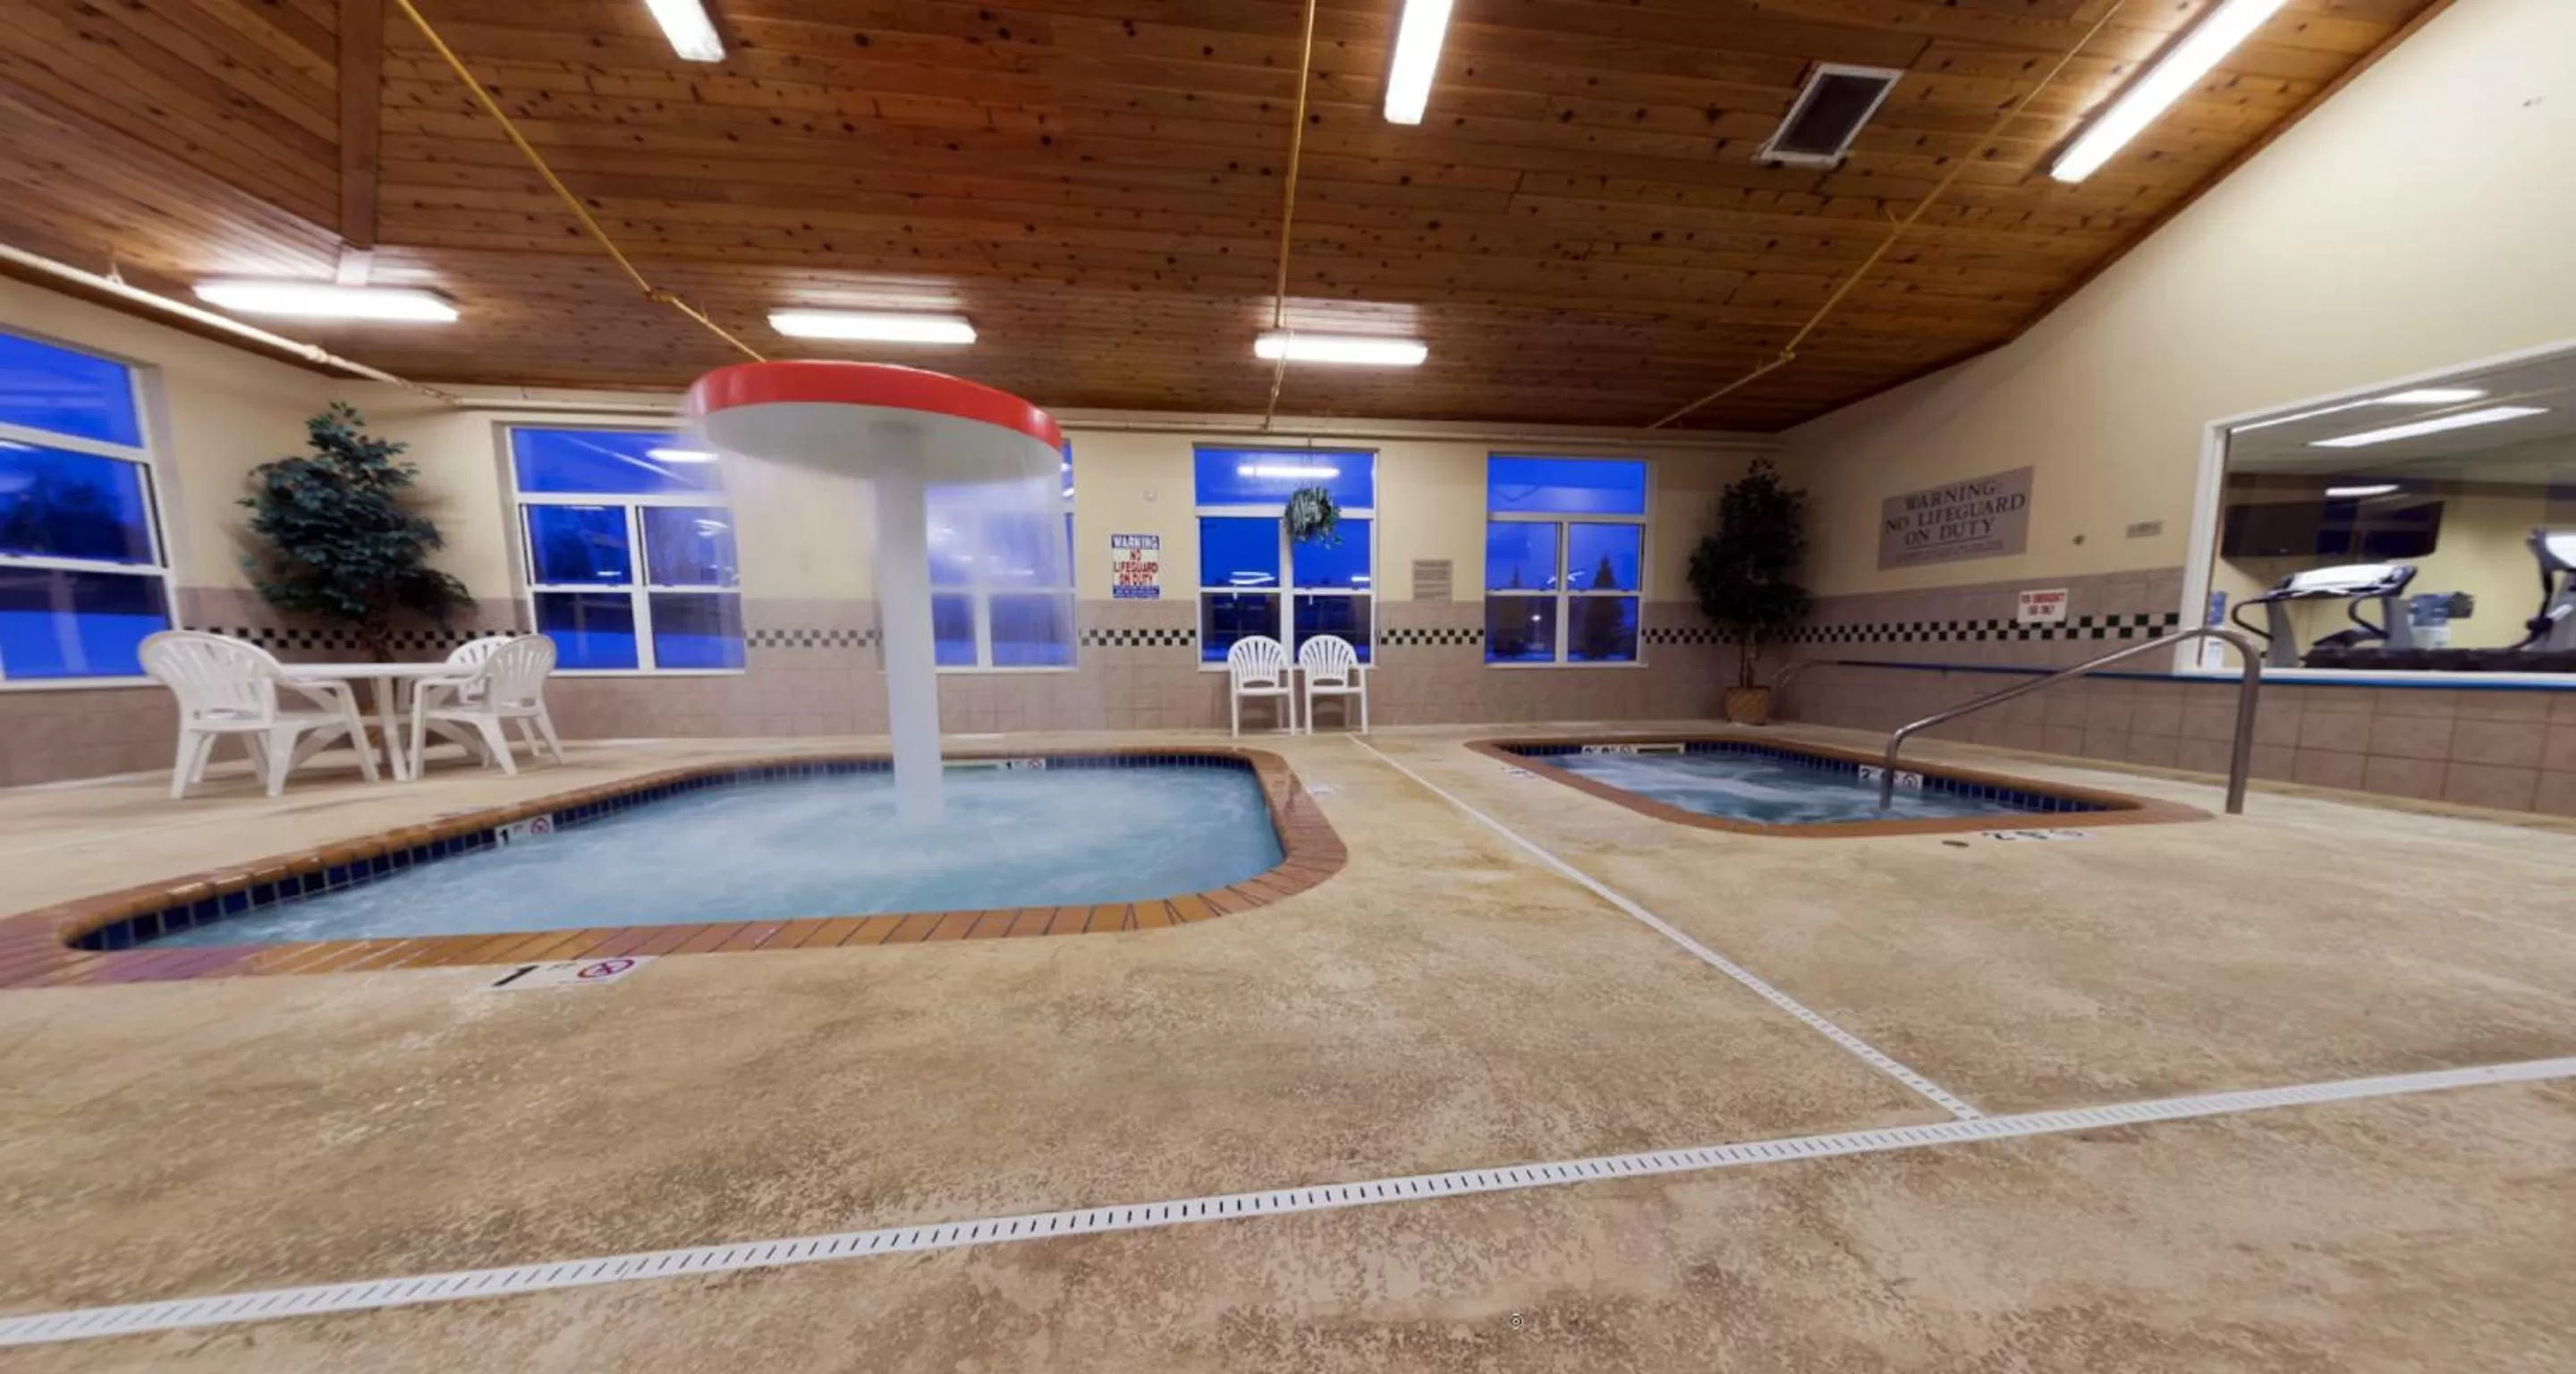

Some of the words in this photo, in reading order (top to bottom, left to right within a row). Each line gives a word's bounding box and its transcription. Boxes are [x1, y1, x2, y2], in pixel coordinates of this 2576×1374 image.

[1885, 516, 1910, 534] NO
[1918, 493, 2026, 527] LIFEGUARD
[1904, 529, 1929, 546] ON
[1938, 517, 1996, 540] DUTY
[1113, 536, 1159, 549] WARNING
[1130, 548, 1140, 560] NO
[1114, 561, 1158, 572] LIFEGUARD
